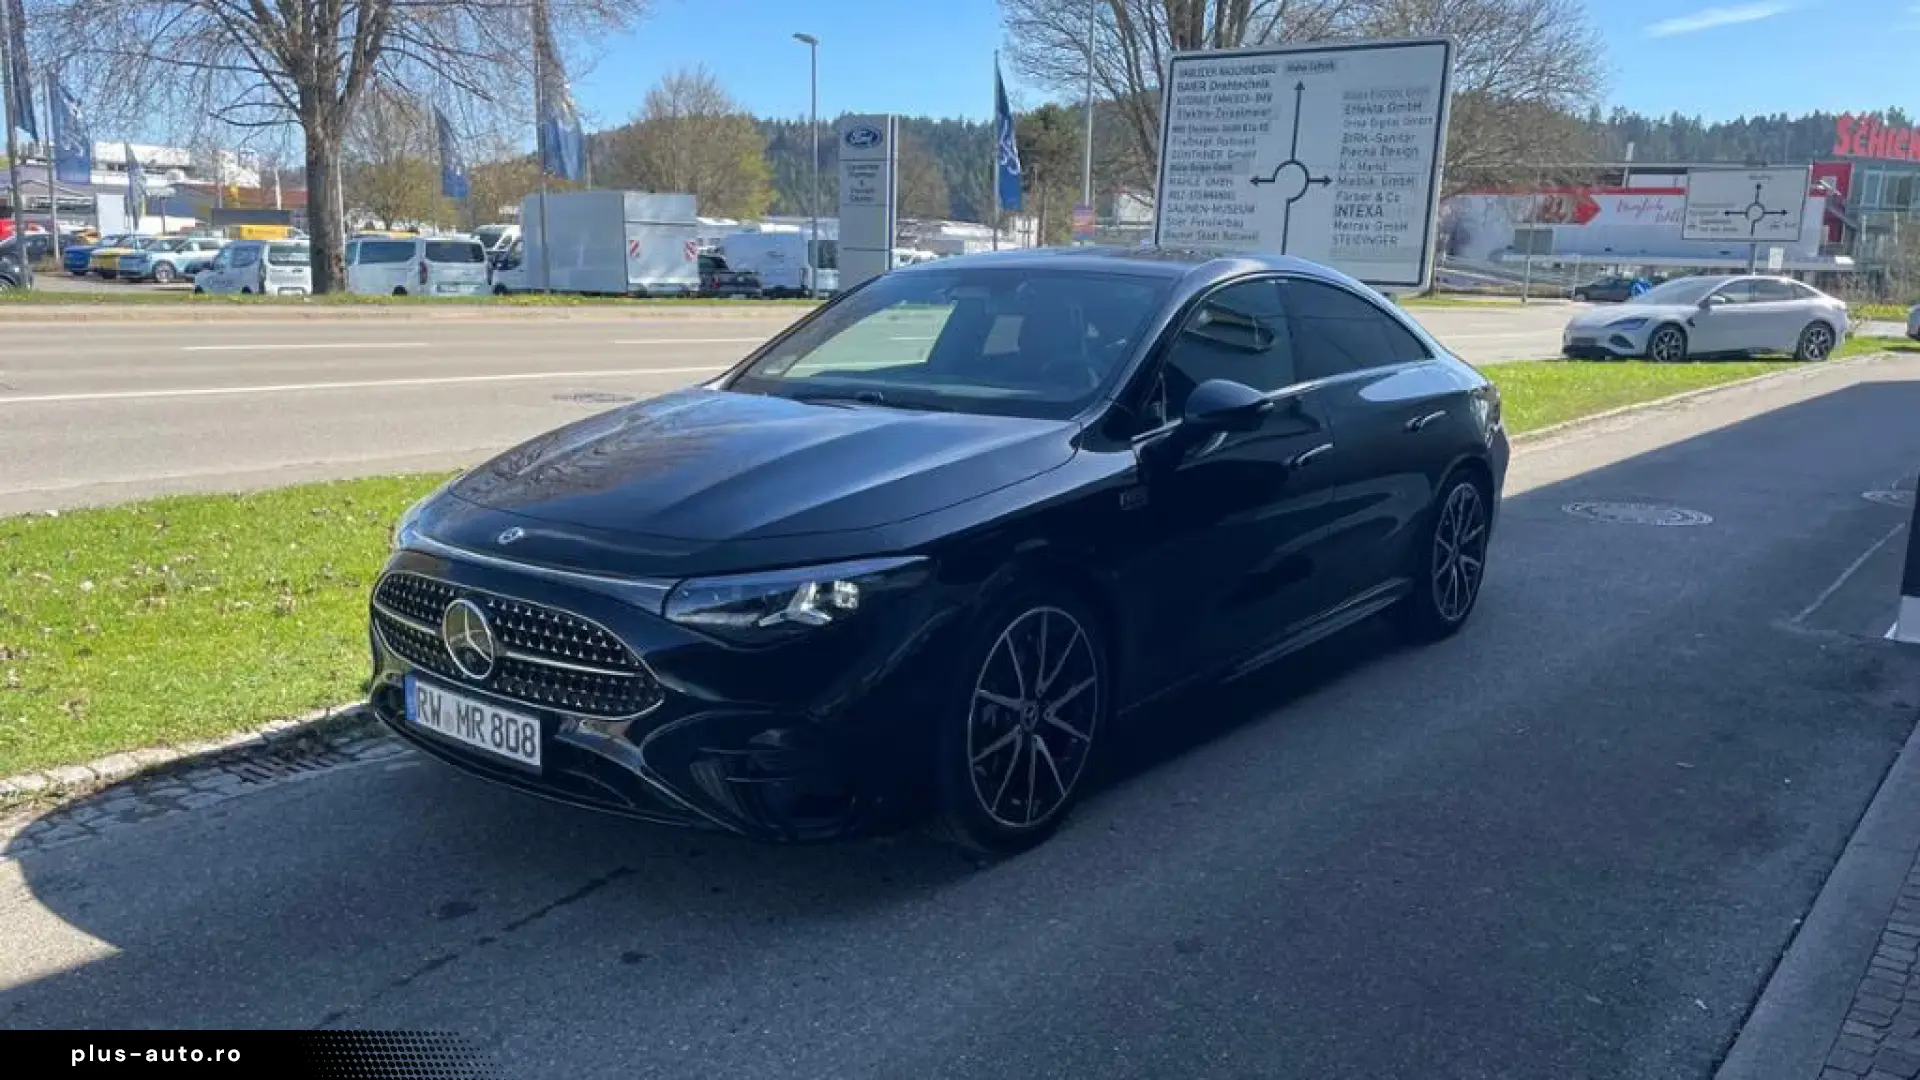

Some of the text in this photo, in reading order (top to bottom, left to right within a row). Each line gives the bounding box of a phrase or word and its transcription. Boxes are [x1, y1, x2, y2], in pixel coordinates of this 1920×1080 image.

[1334, 203, 1383, 218] INTEXA
[418, 686, 536, 758] RW MR 808
